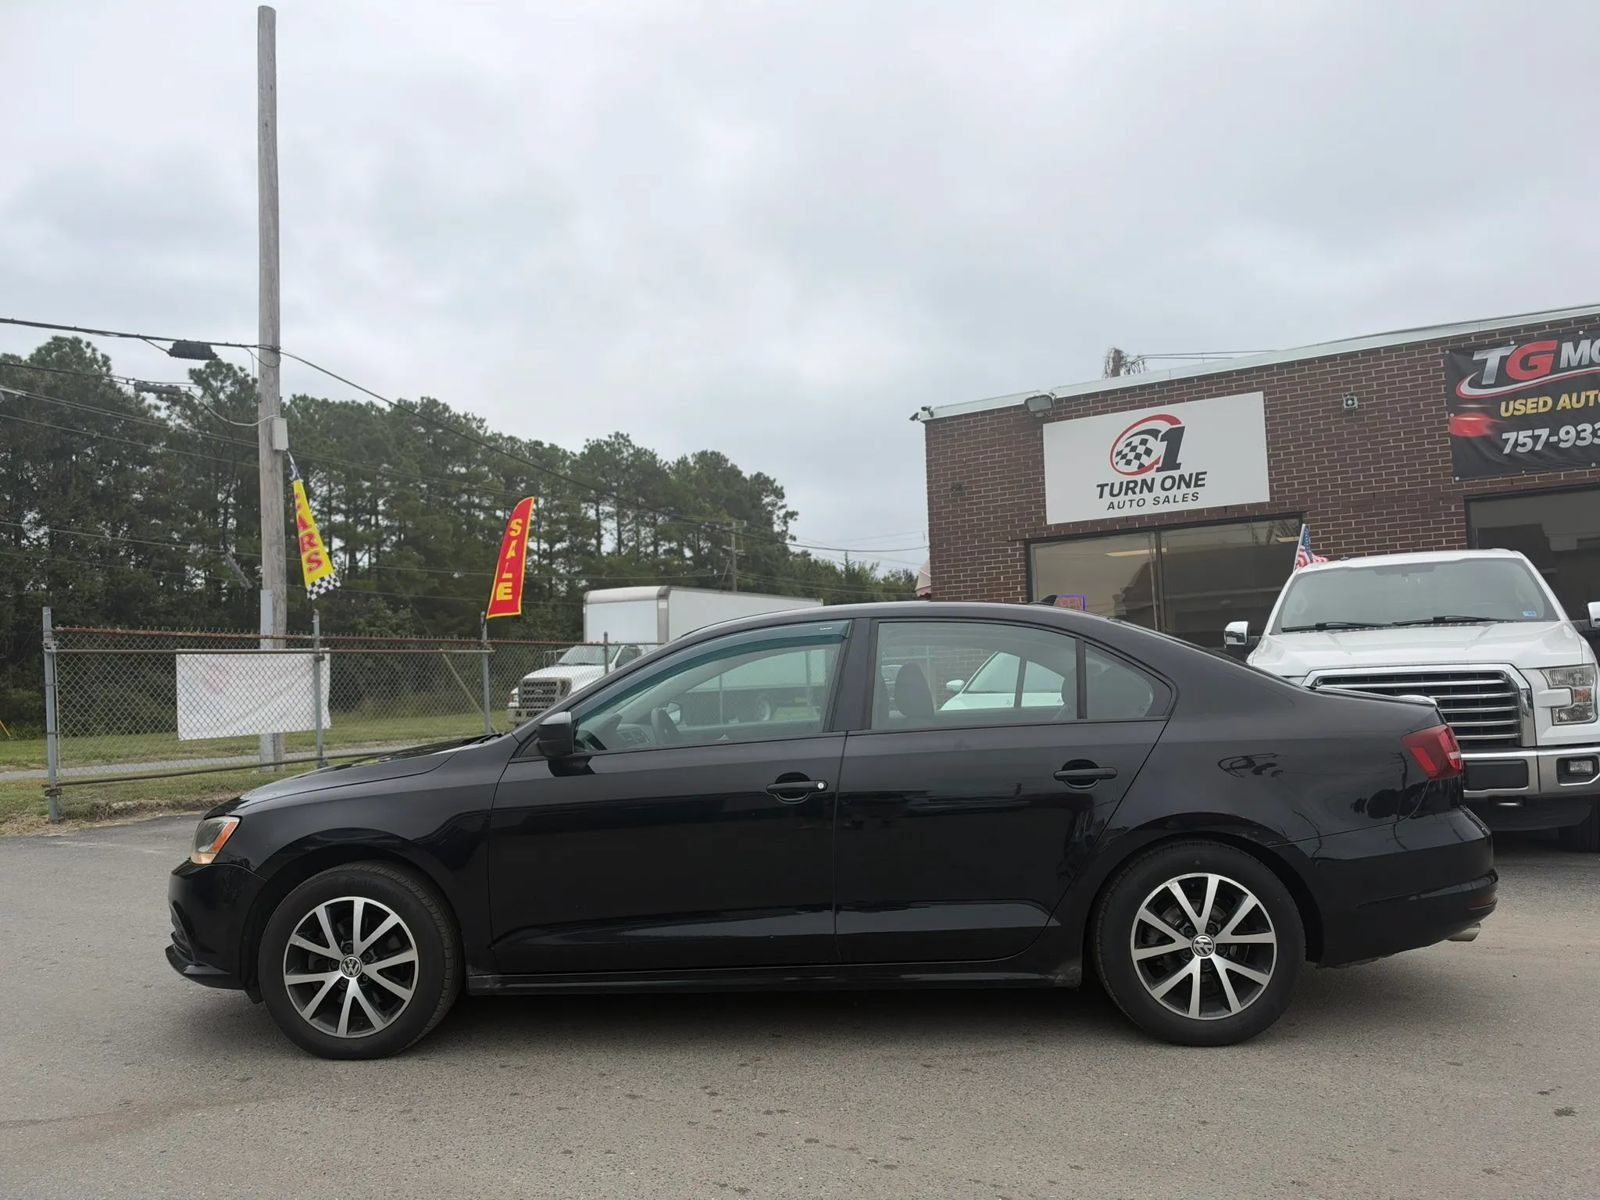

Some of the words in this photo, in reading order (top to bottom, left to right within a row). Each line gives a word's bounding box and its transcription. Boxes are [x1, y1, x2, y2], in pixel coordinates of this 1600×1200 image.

[1472, 339, 1558, 385] TG
[1500, 396, 1553, 417] USED
[1556, 389, 1600, 411] AUT
[1096, 477, 1156, 499] TURN
[1160, 471, 1208, 492] ONE
[1107, 498, 1146, 511] AUTO
[1152, 491, 1200, 506] SALES
[496, 518, 523, 600] SALE
